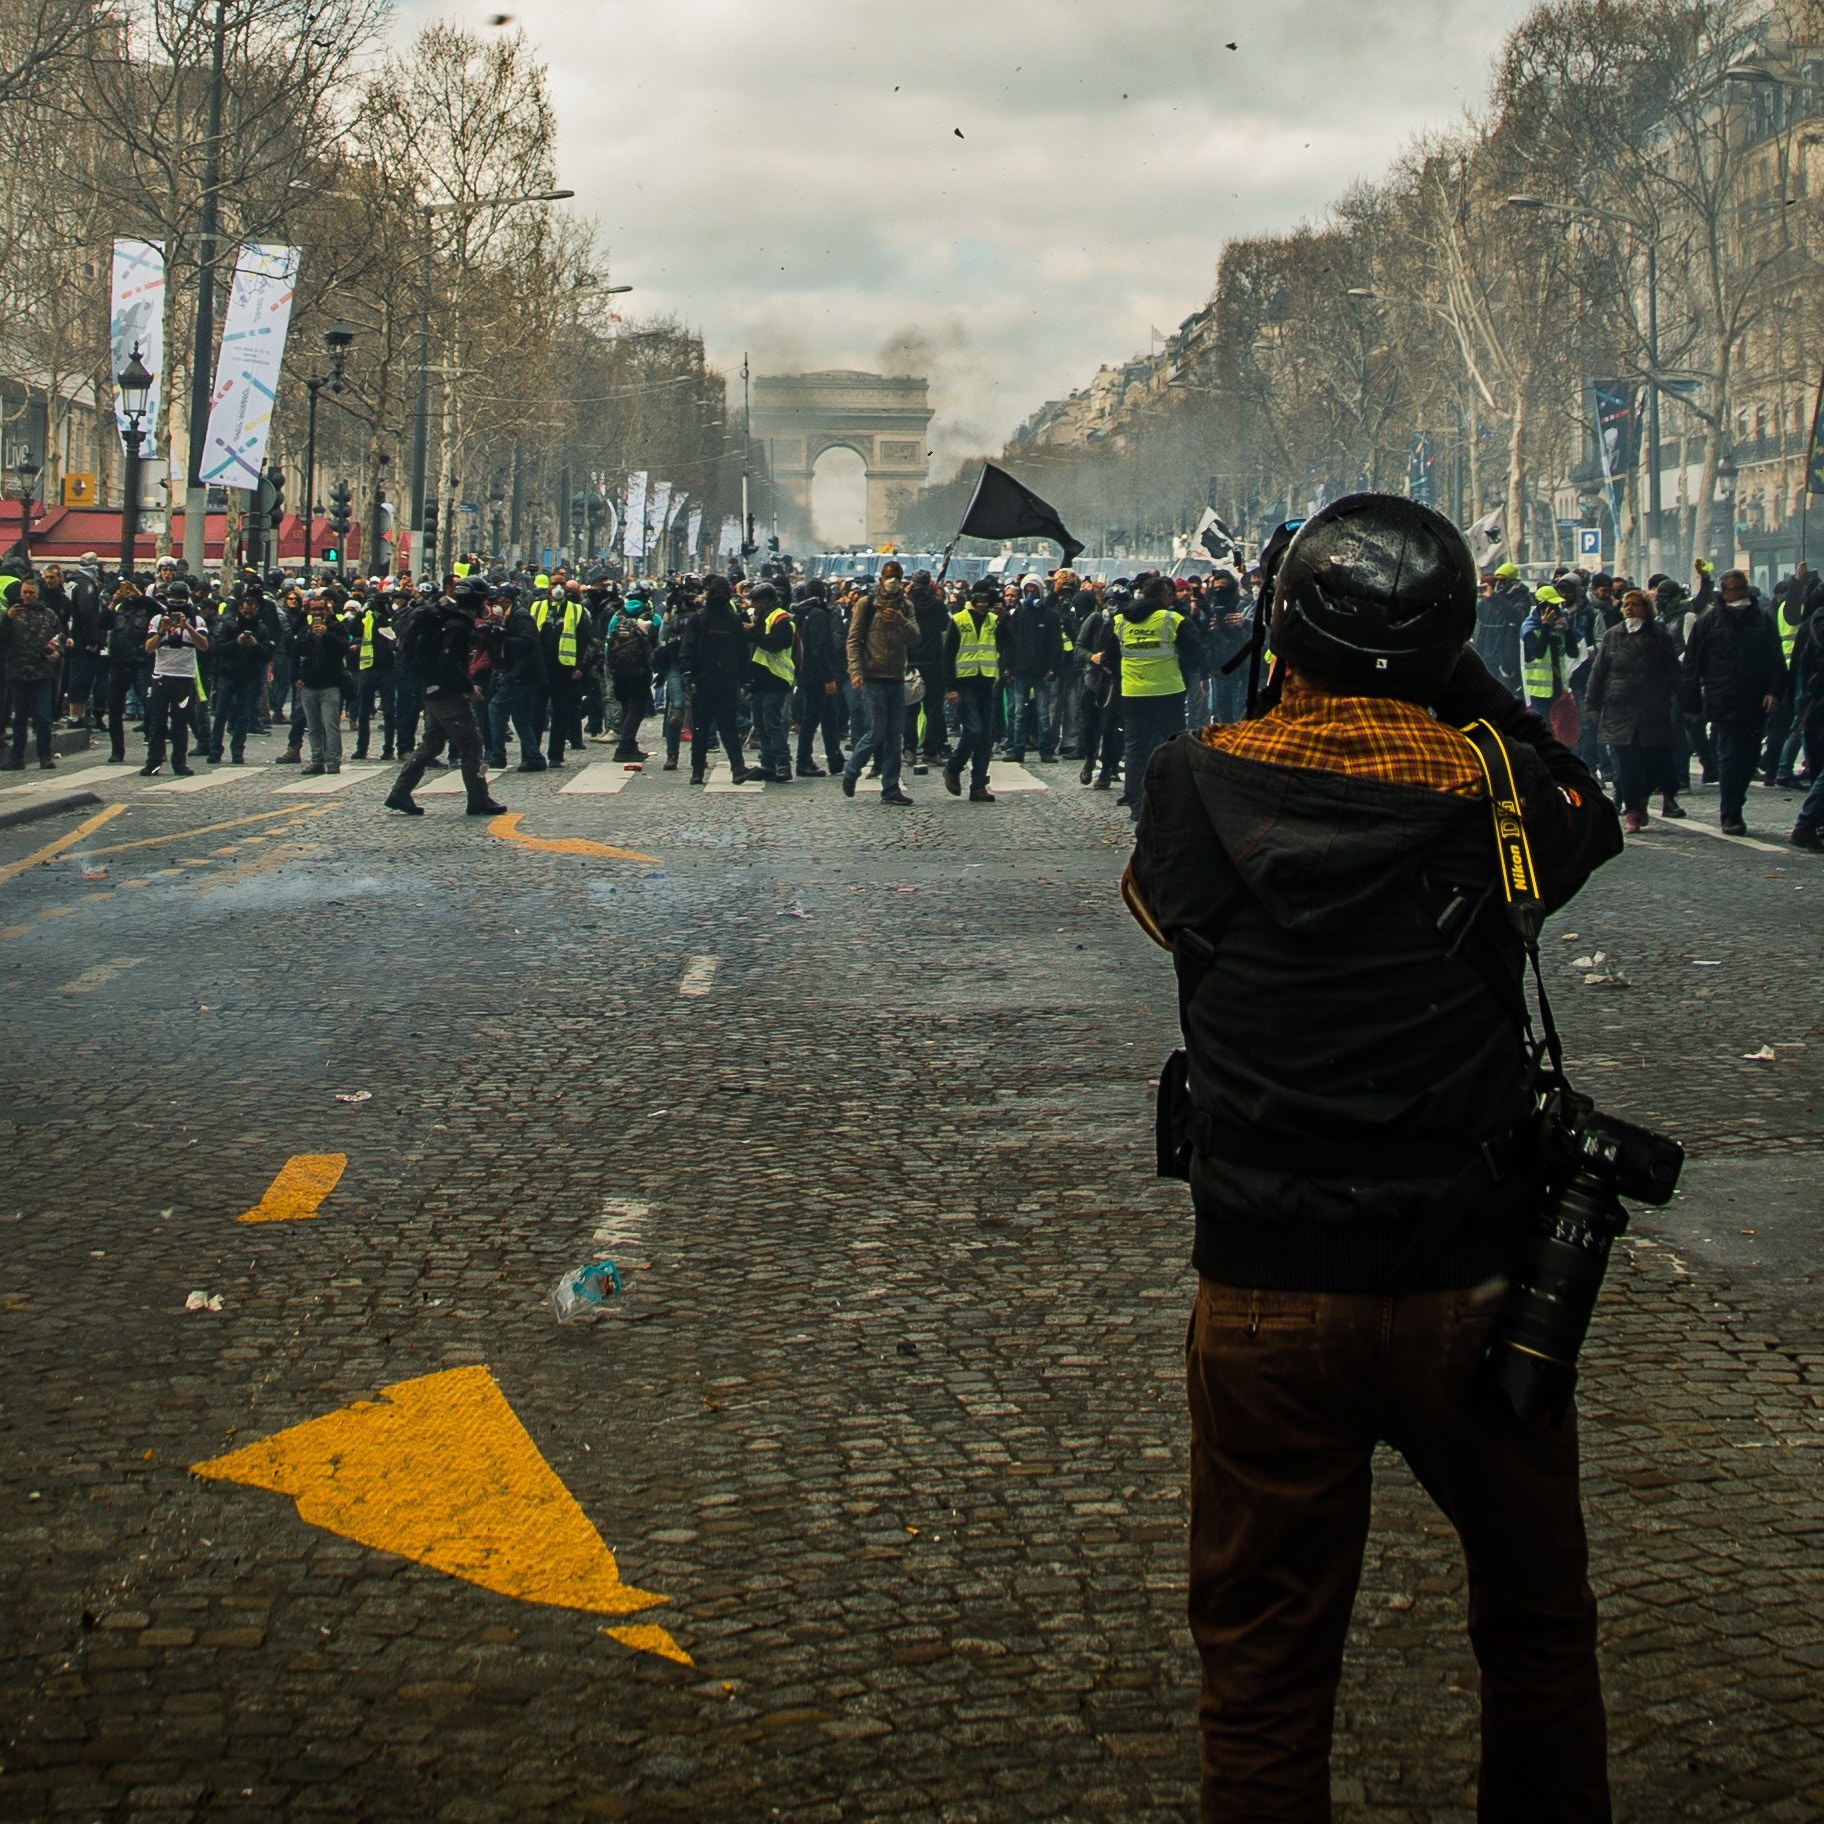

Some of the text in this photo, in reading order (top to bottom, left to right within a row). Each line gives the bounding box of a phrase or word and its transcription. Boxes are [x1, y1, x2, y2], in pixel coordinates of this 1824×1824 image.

[1584, 533, 1596, 552] P
[1129, 628, 1156, 636] FORCE
[1509, 844, 1528, 891] Nikon
